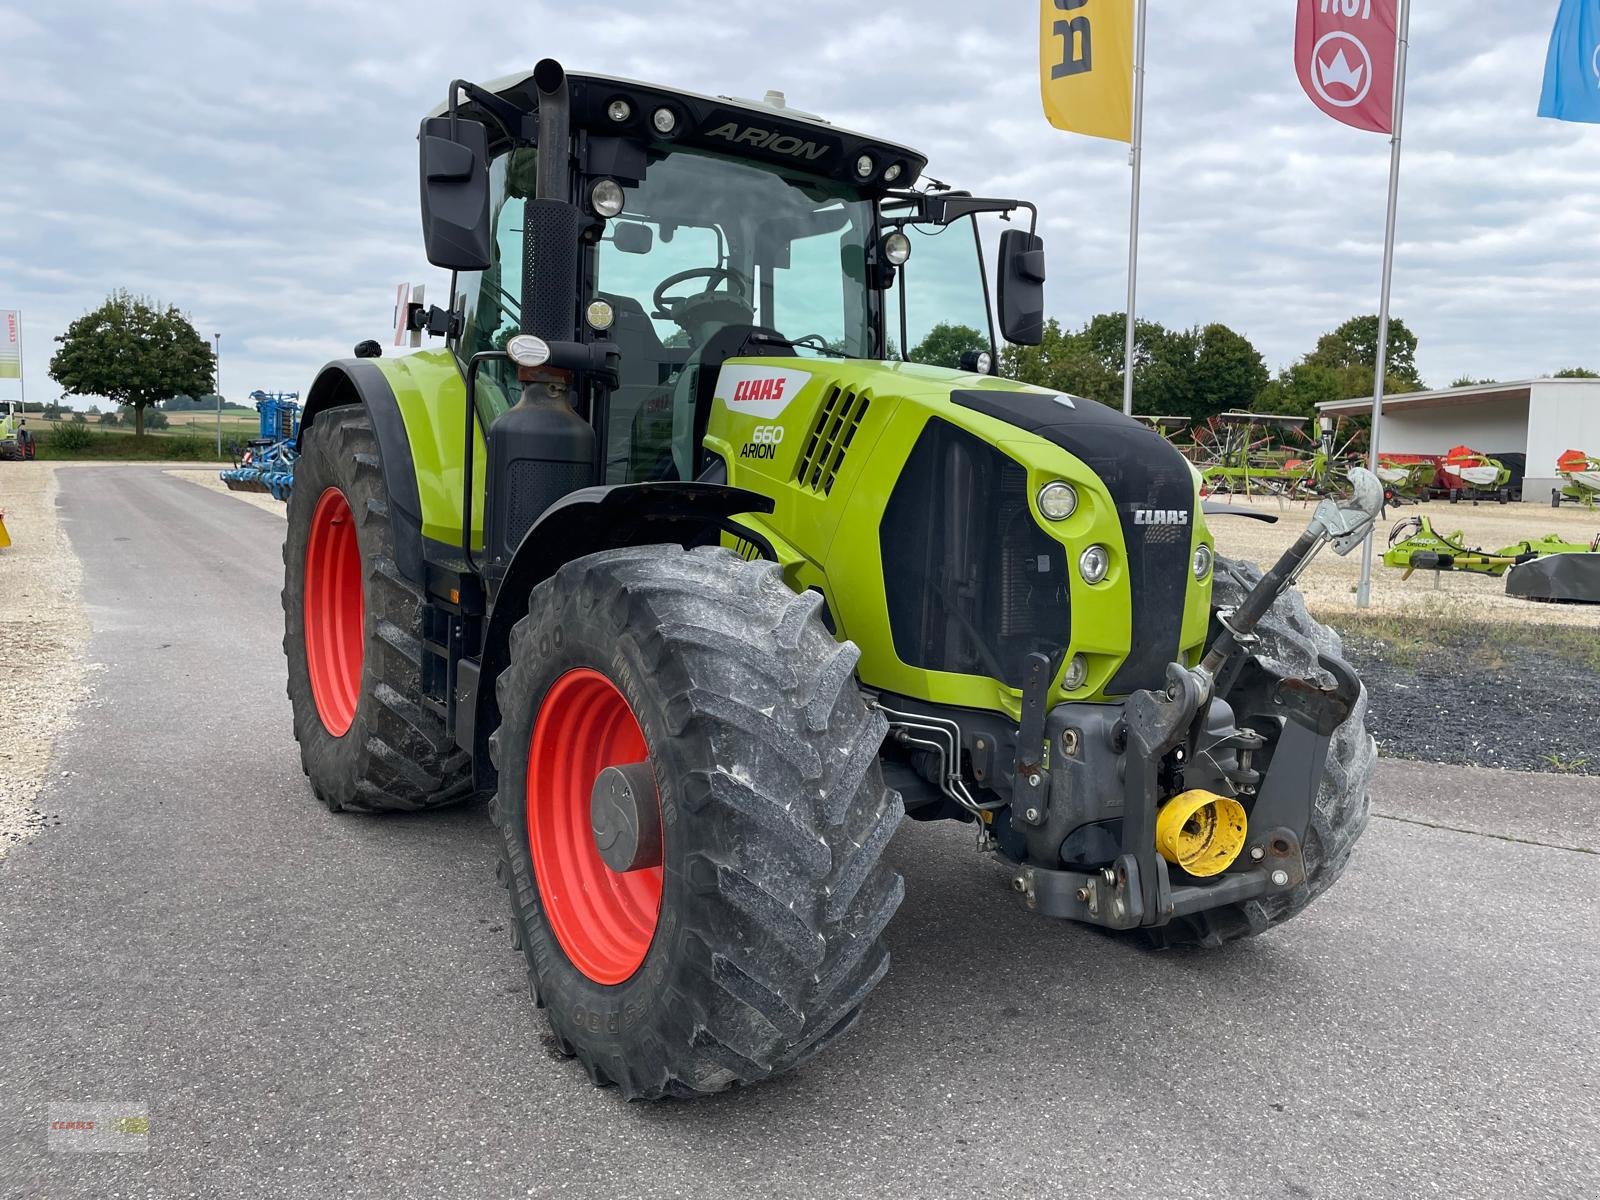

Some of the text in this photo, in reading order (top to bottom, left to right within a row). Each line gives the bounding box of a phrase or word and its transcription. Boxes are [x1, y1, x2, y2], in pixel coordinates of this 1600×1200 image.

[734, 377, 786, 401] CLAAS
[753, 425, 784, 444] 660
[740, 443, 776, 459] ARION
[1133, 510, 1188, 525] CLAAS
